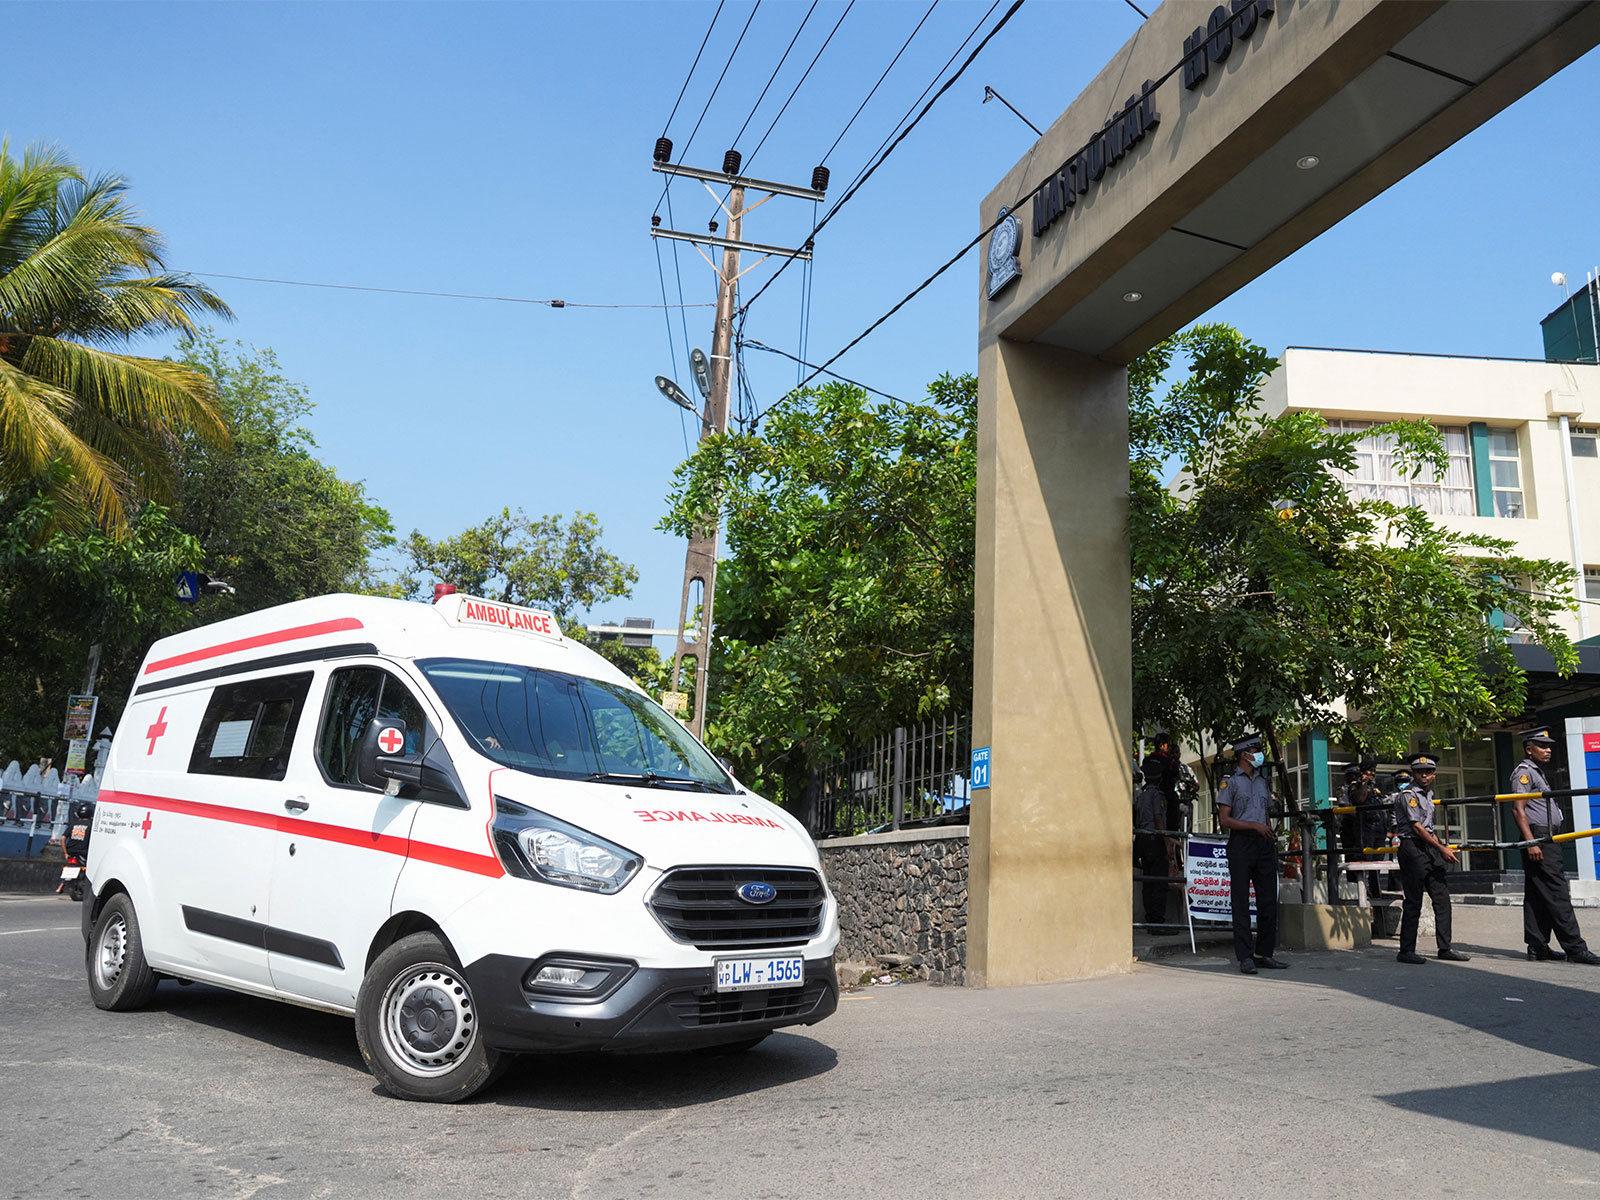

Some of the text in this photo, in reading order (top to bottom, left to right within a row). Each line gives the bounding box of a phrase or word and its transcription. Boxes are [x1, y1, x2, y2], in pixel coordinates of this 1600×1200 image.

[1033, 0, 1275, 237] NATIONAL HOS
[466, 602, 552, 634] AMBULANCE
[973, 751, 988, 762] GATE
[974, 764, 987, 785] 01
[750, 884, 772, 898] Ford
[719, 973, 731, 985] WP
[767, 960, 801, 982] 1565
